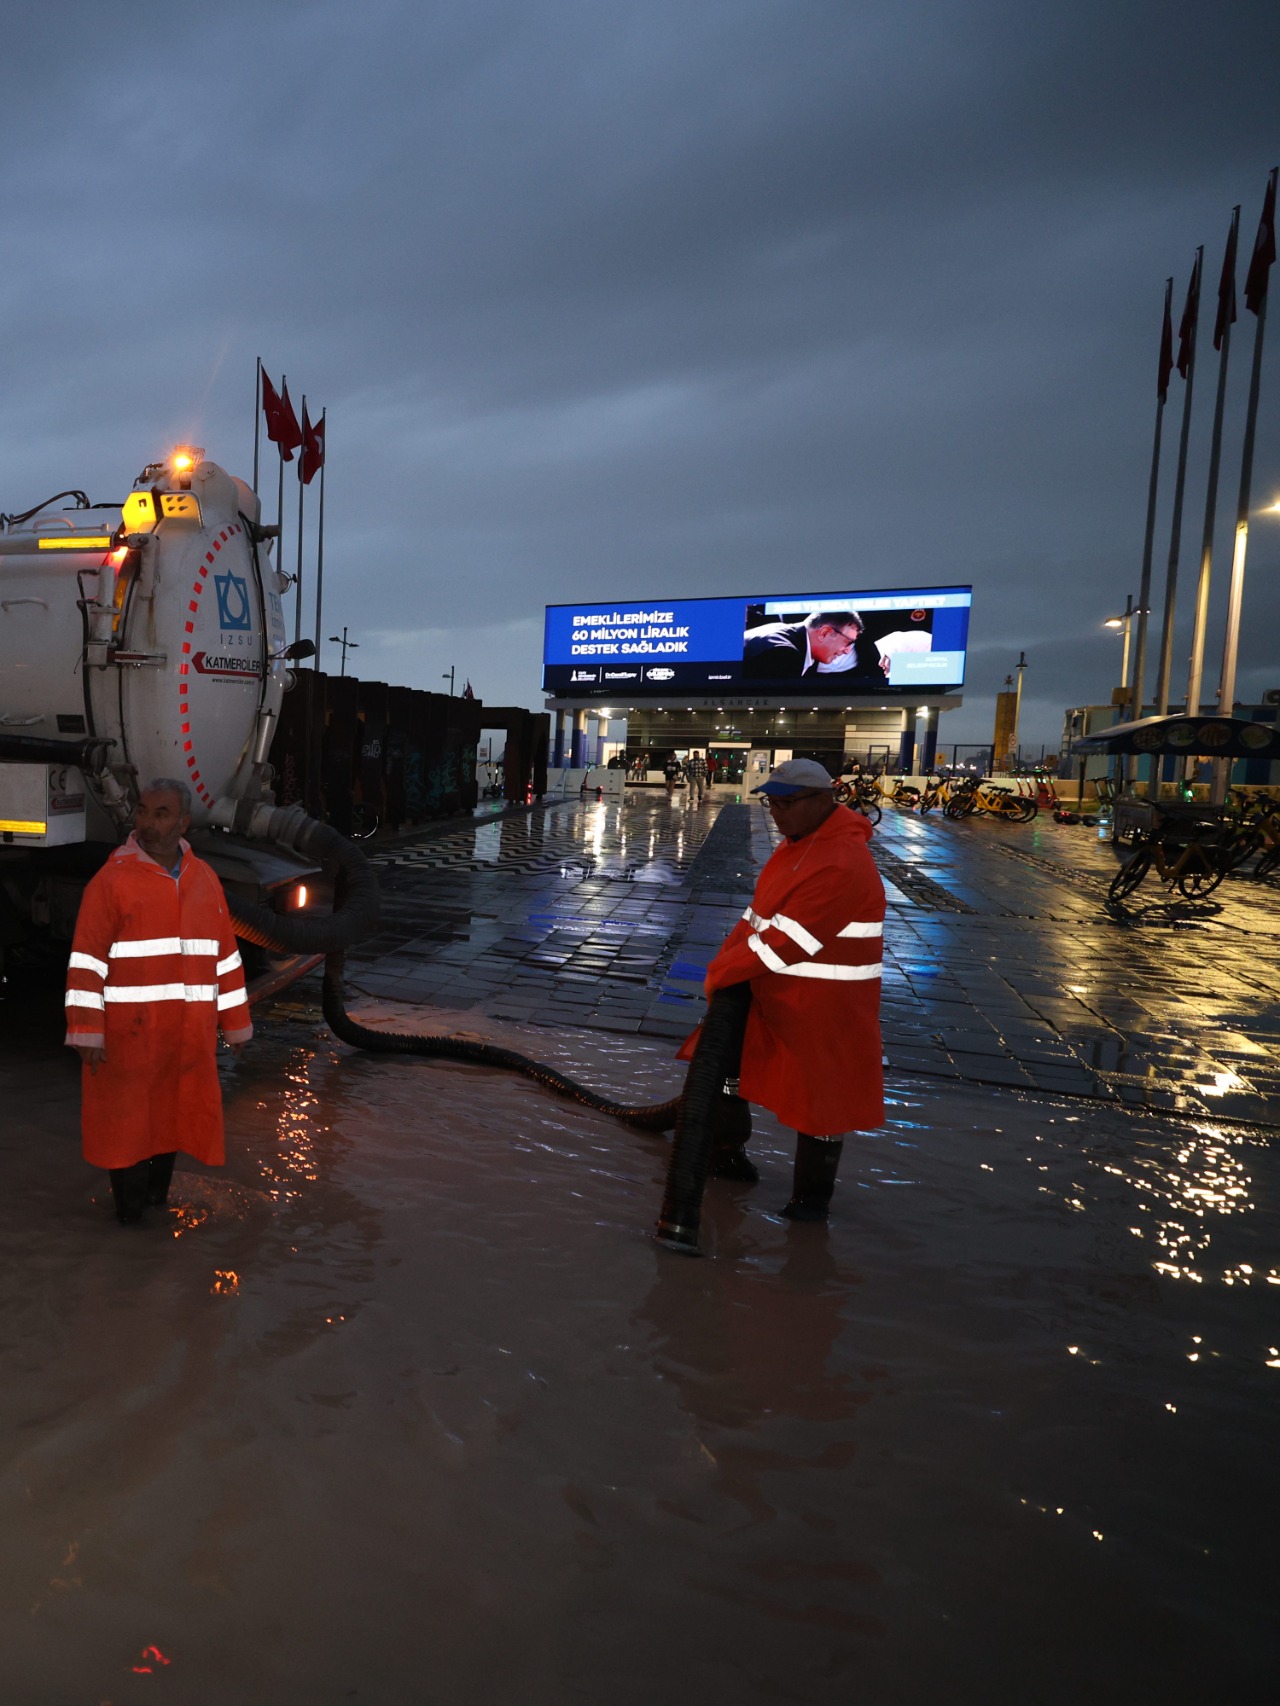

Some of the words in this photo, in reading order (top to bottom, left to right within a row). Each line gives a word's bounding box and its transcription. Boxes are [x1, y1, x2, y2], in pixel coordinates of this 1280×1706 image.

[572, 610, 674, 626] EMEKLİLERİMİZE
[571, 629, 589, 641] 60
[590, 627, 638, 640] MİLYON
[640, 626, 690, 639] LİRALIK
[571, 643, 619, 655] DESTEK
[621, 640, 688, 654] SAĞLADIK
[703, 698, 769, 707] ALSANCAK
